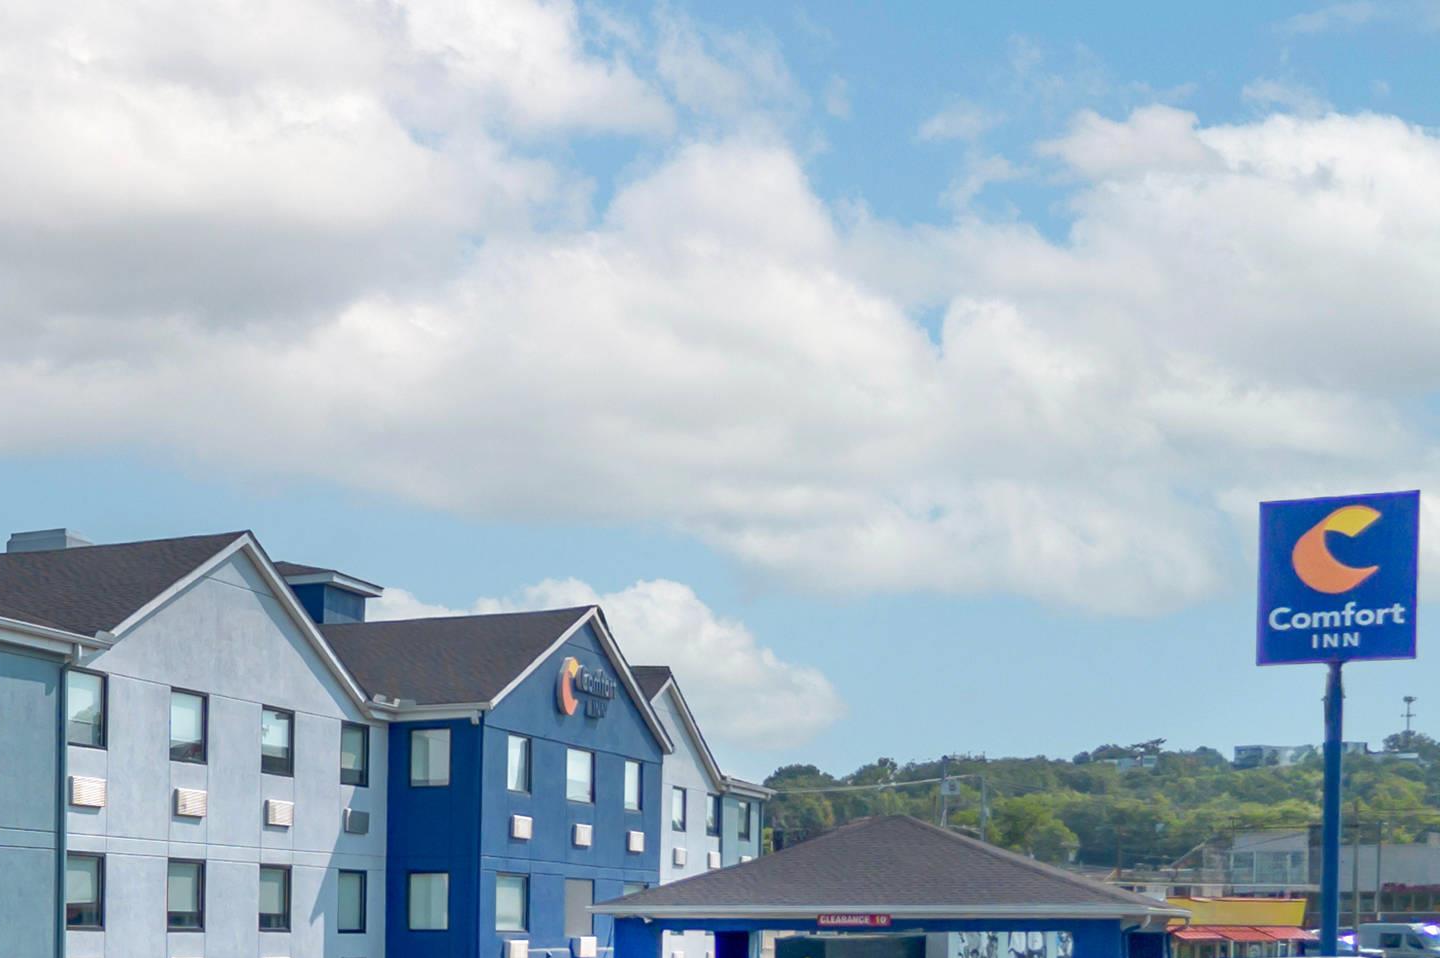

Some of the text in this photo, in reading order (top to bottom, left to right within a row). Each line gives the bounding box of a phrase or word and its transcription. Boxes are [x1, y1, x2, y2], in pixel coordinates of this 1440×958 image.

[1268, 601, 1406, 631] Comfort
[1312, 632, 1360, 649] INN
[575, 664, 617, 700] Comfort
[819, 914, 871, 925] CLEARANCE
